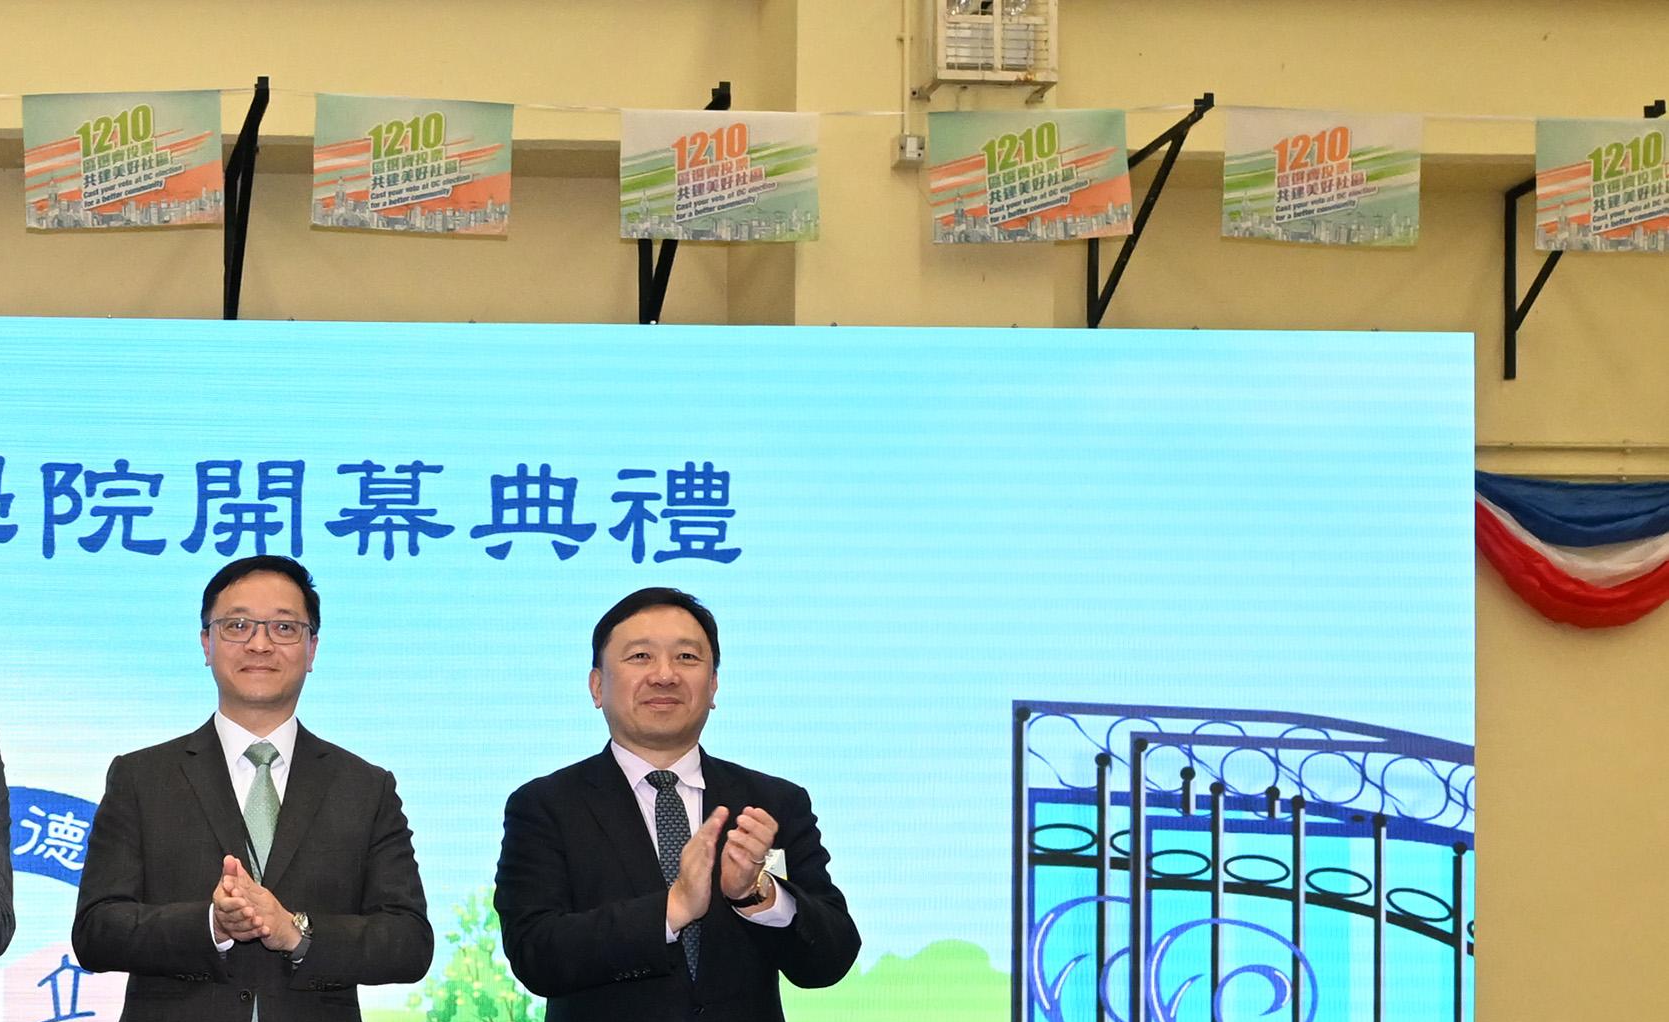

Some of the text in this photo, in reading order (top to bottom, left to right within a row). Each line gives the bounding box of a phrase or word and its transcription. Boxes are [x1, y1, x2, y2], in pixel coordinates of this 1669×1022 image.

[76, 104, 152, 158] 1210
[368, 112, 443, 160] 1210
[672, 122, 748, 171] 1210
[981, 121, 1057, 175] 1210
[1273, 125, 1350, 173] 1210
[1587, 131, 1664, 183] 1210
[1593, 176, 1668, 213] 共建美好社
